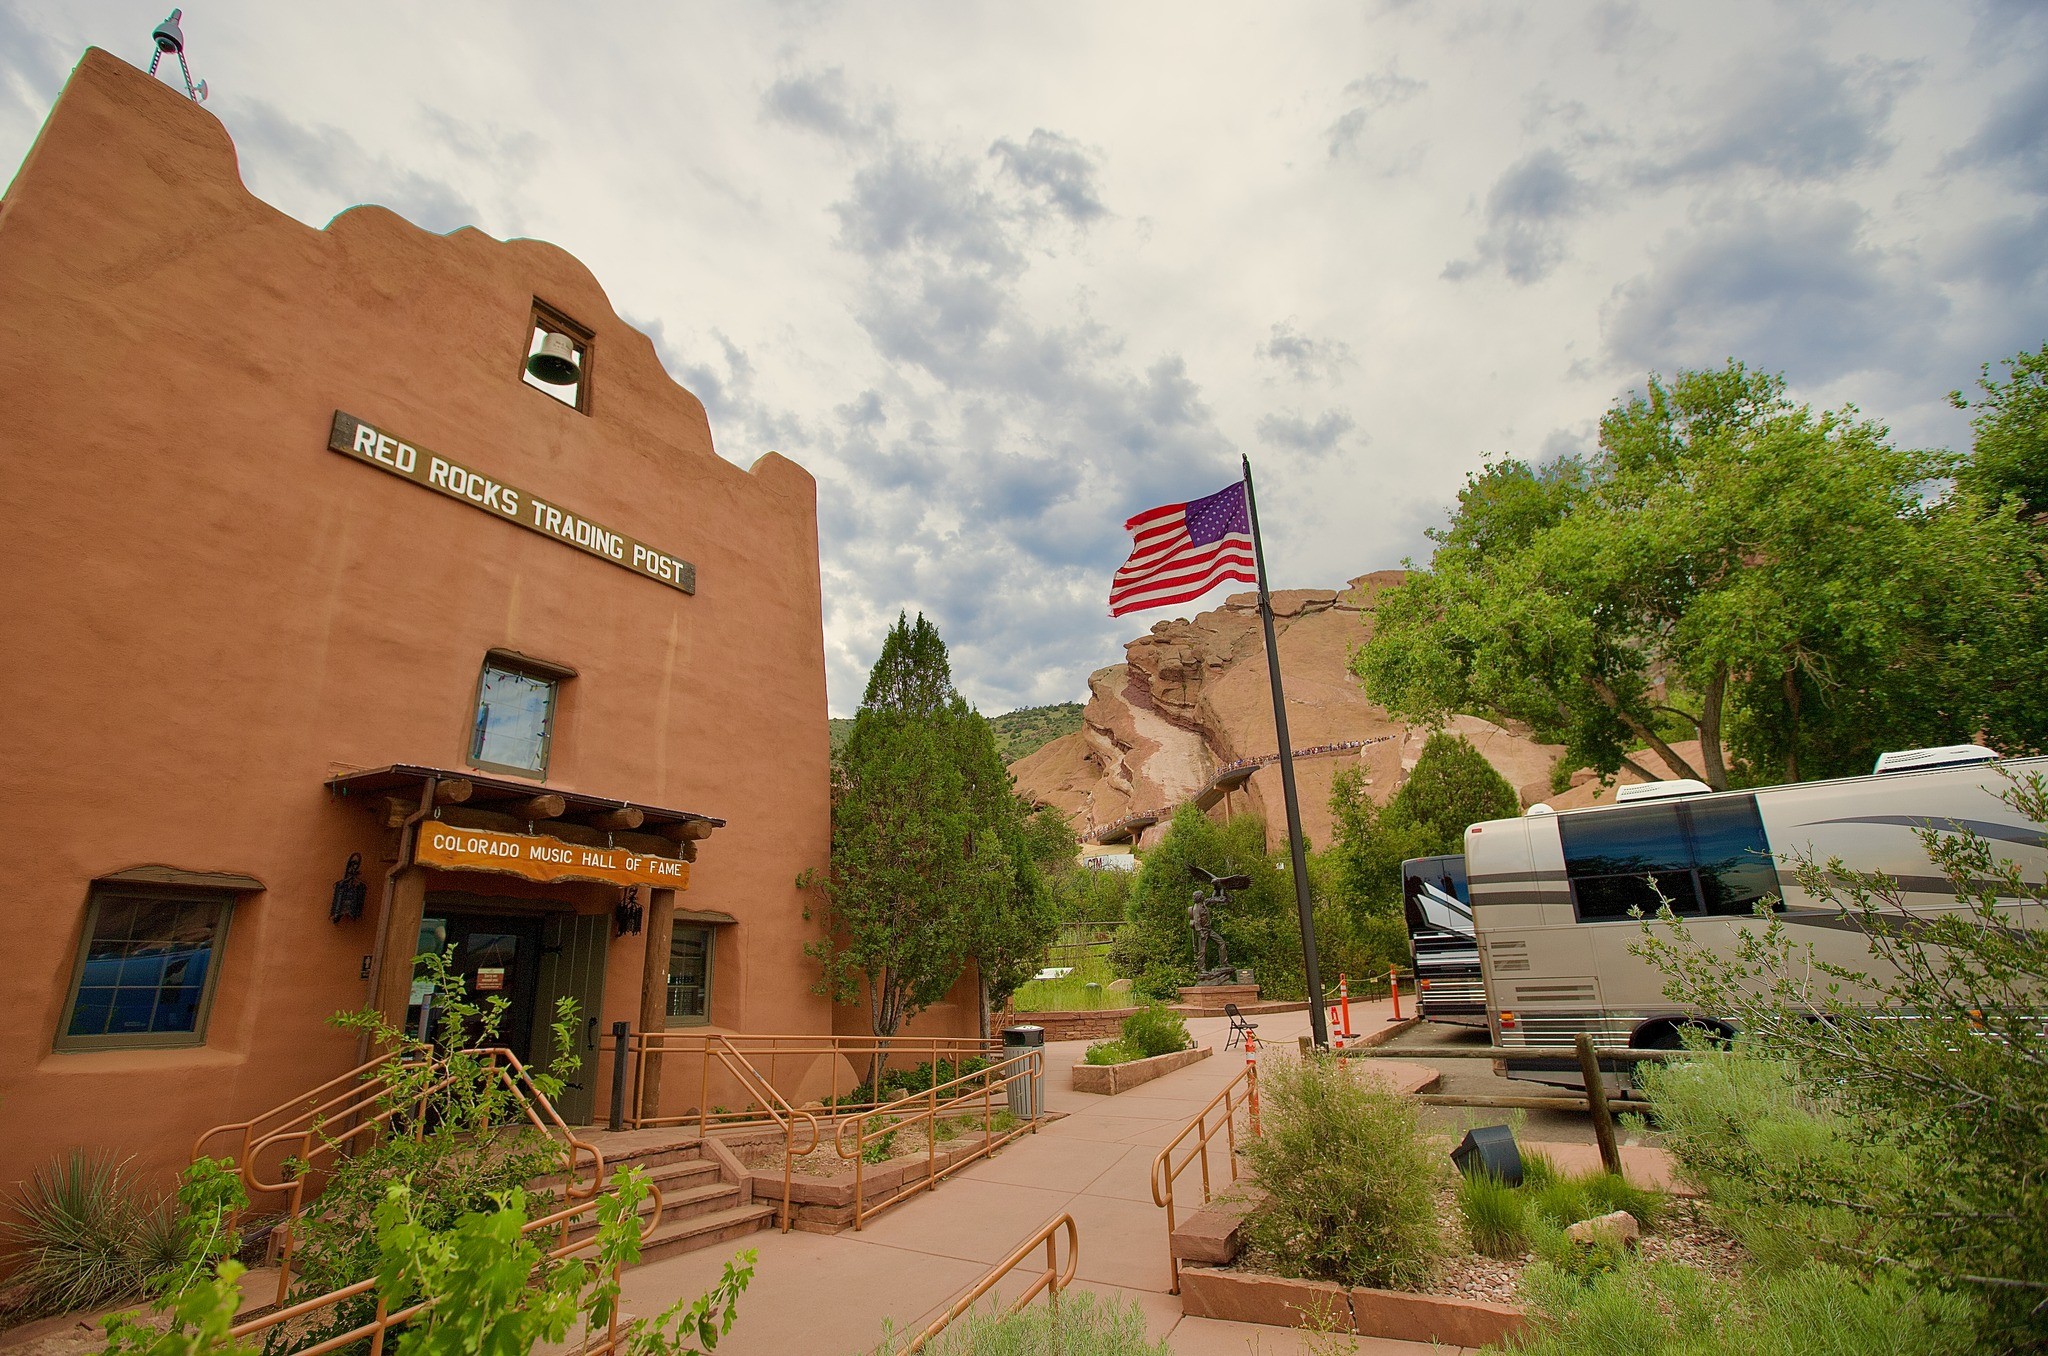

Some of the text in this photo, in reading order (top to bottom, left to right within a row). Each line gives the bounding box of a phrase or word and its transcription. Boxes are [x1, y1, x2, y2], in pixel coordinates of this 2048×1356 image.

[353, 424, 684, 583] RED ROCKS TRADING POST
[433, 834, 682, 877] COLORADO MUSIC HALL OF FAME
